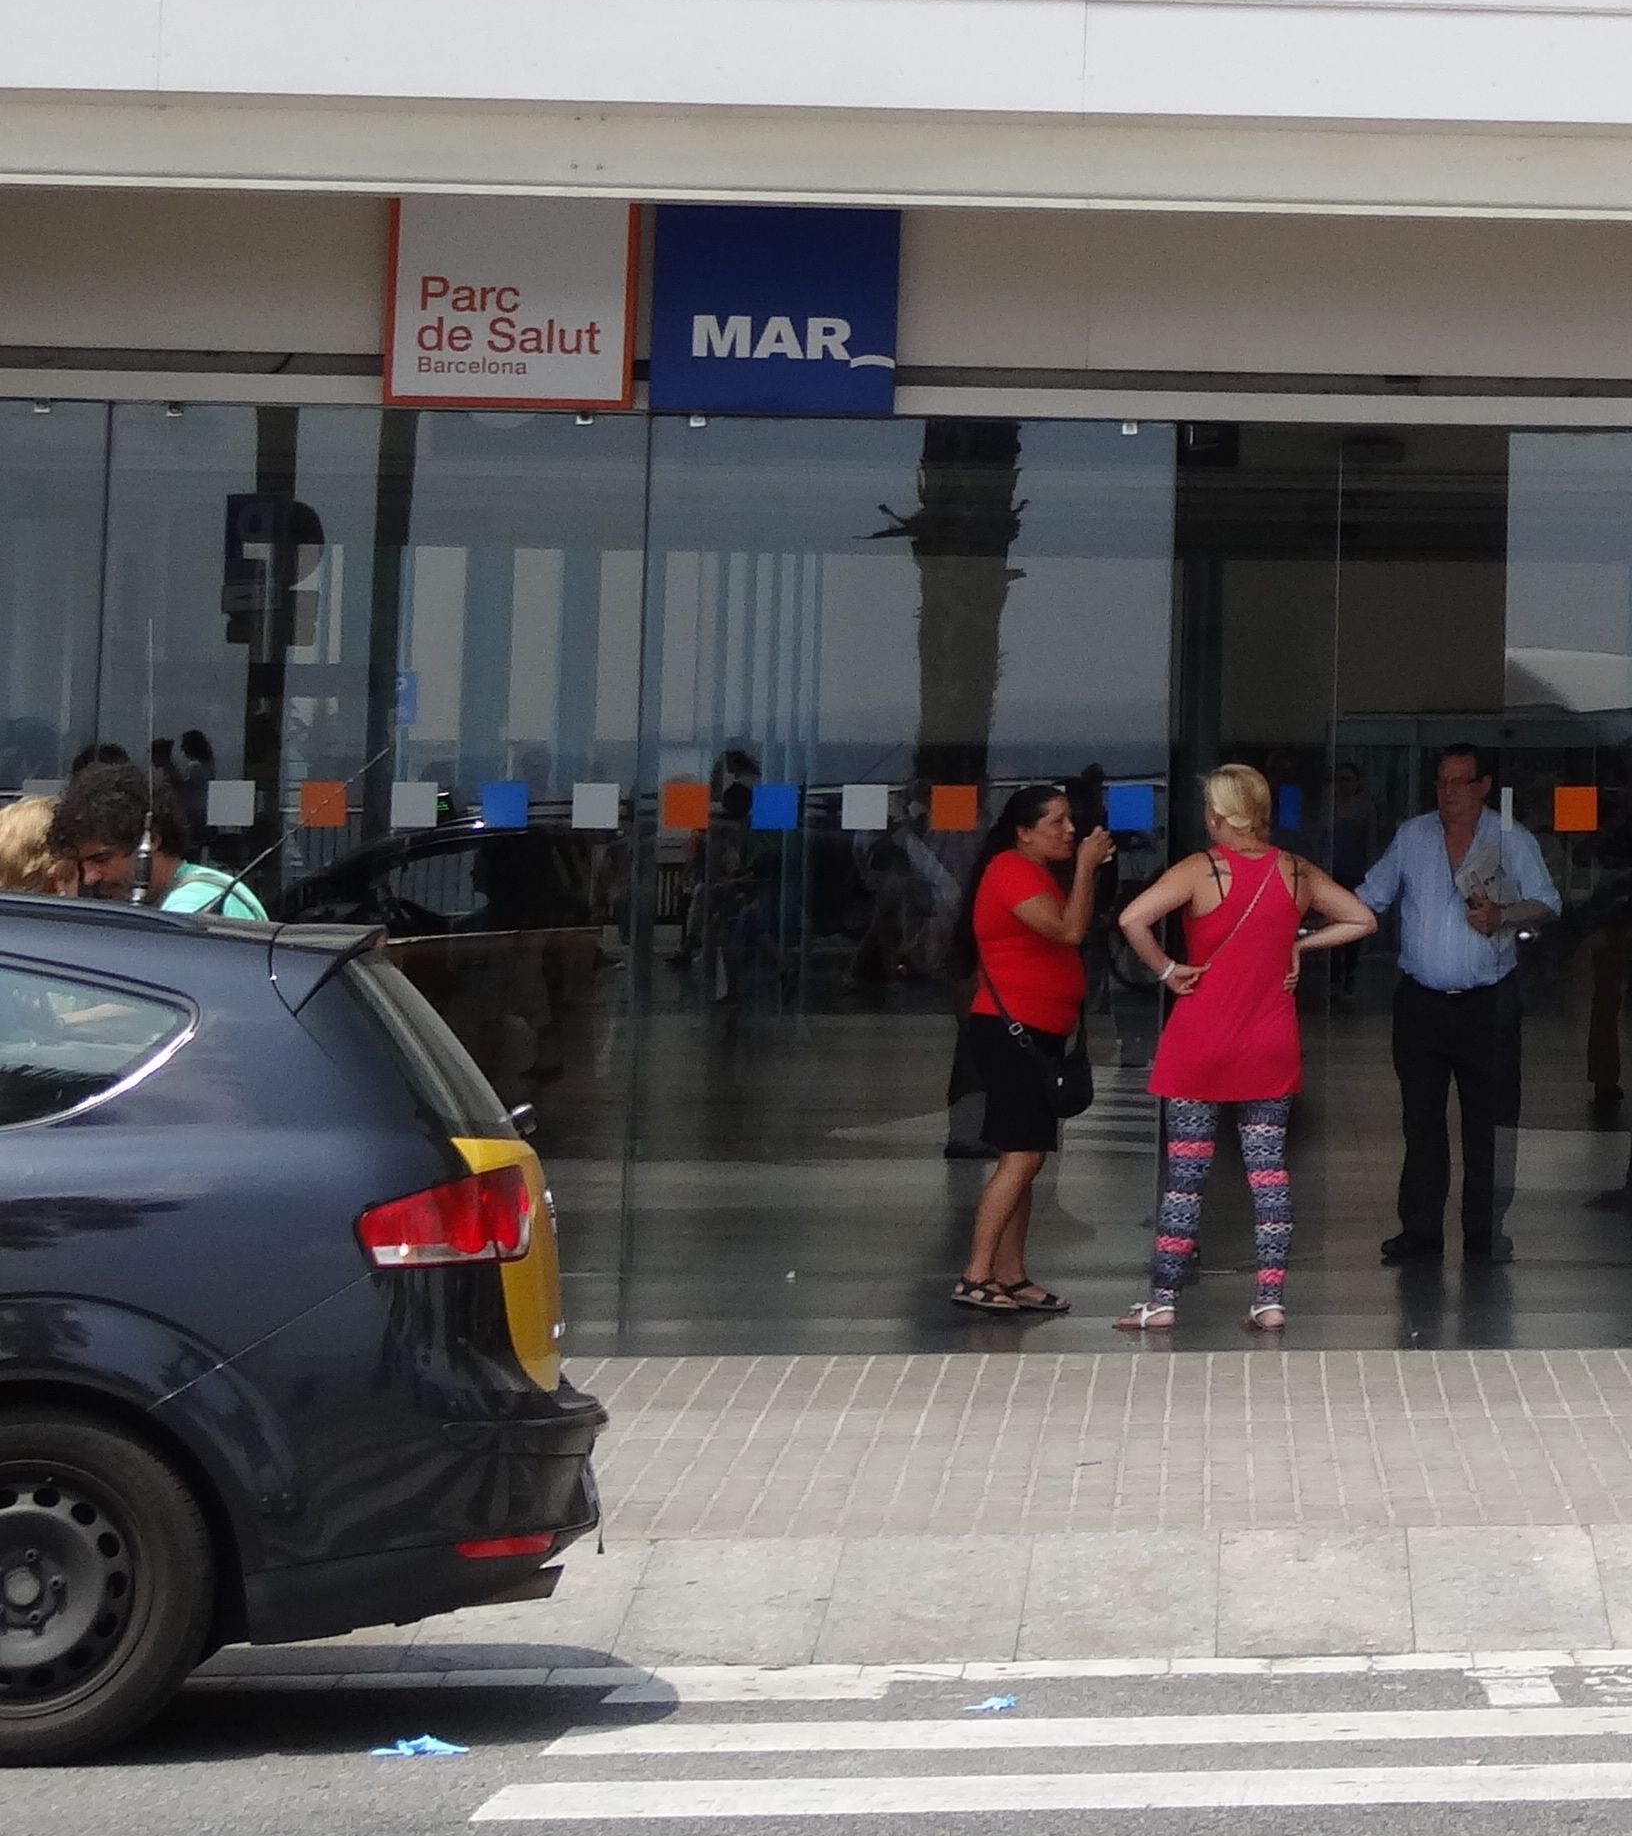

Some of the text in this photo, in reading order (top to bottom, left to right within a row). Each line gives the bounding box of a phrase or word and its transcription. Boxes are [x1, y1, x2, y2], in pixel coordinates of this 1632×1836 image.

[419, 275, 520, 313] Parc
[417, 317, 601, 355] de Salut
[692, 314, 852, 361] MAR
[417, 356, 528, 376] Barcelona
